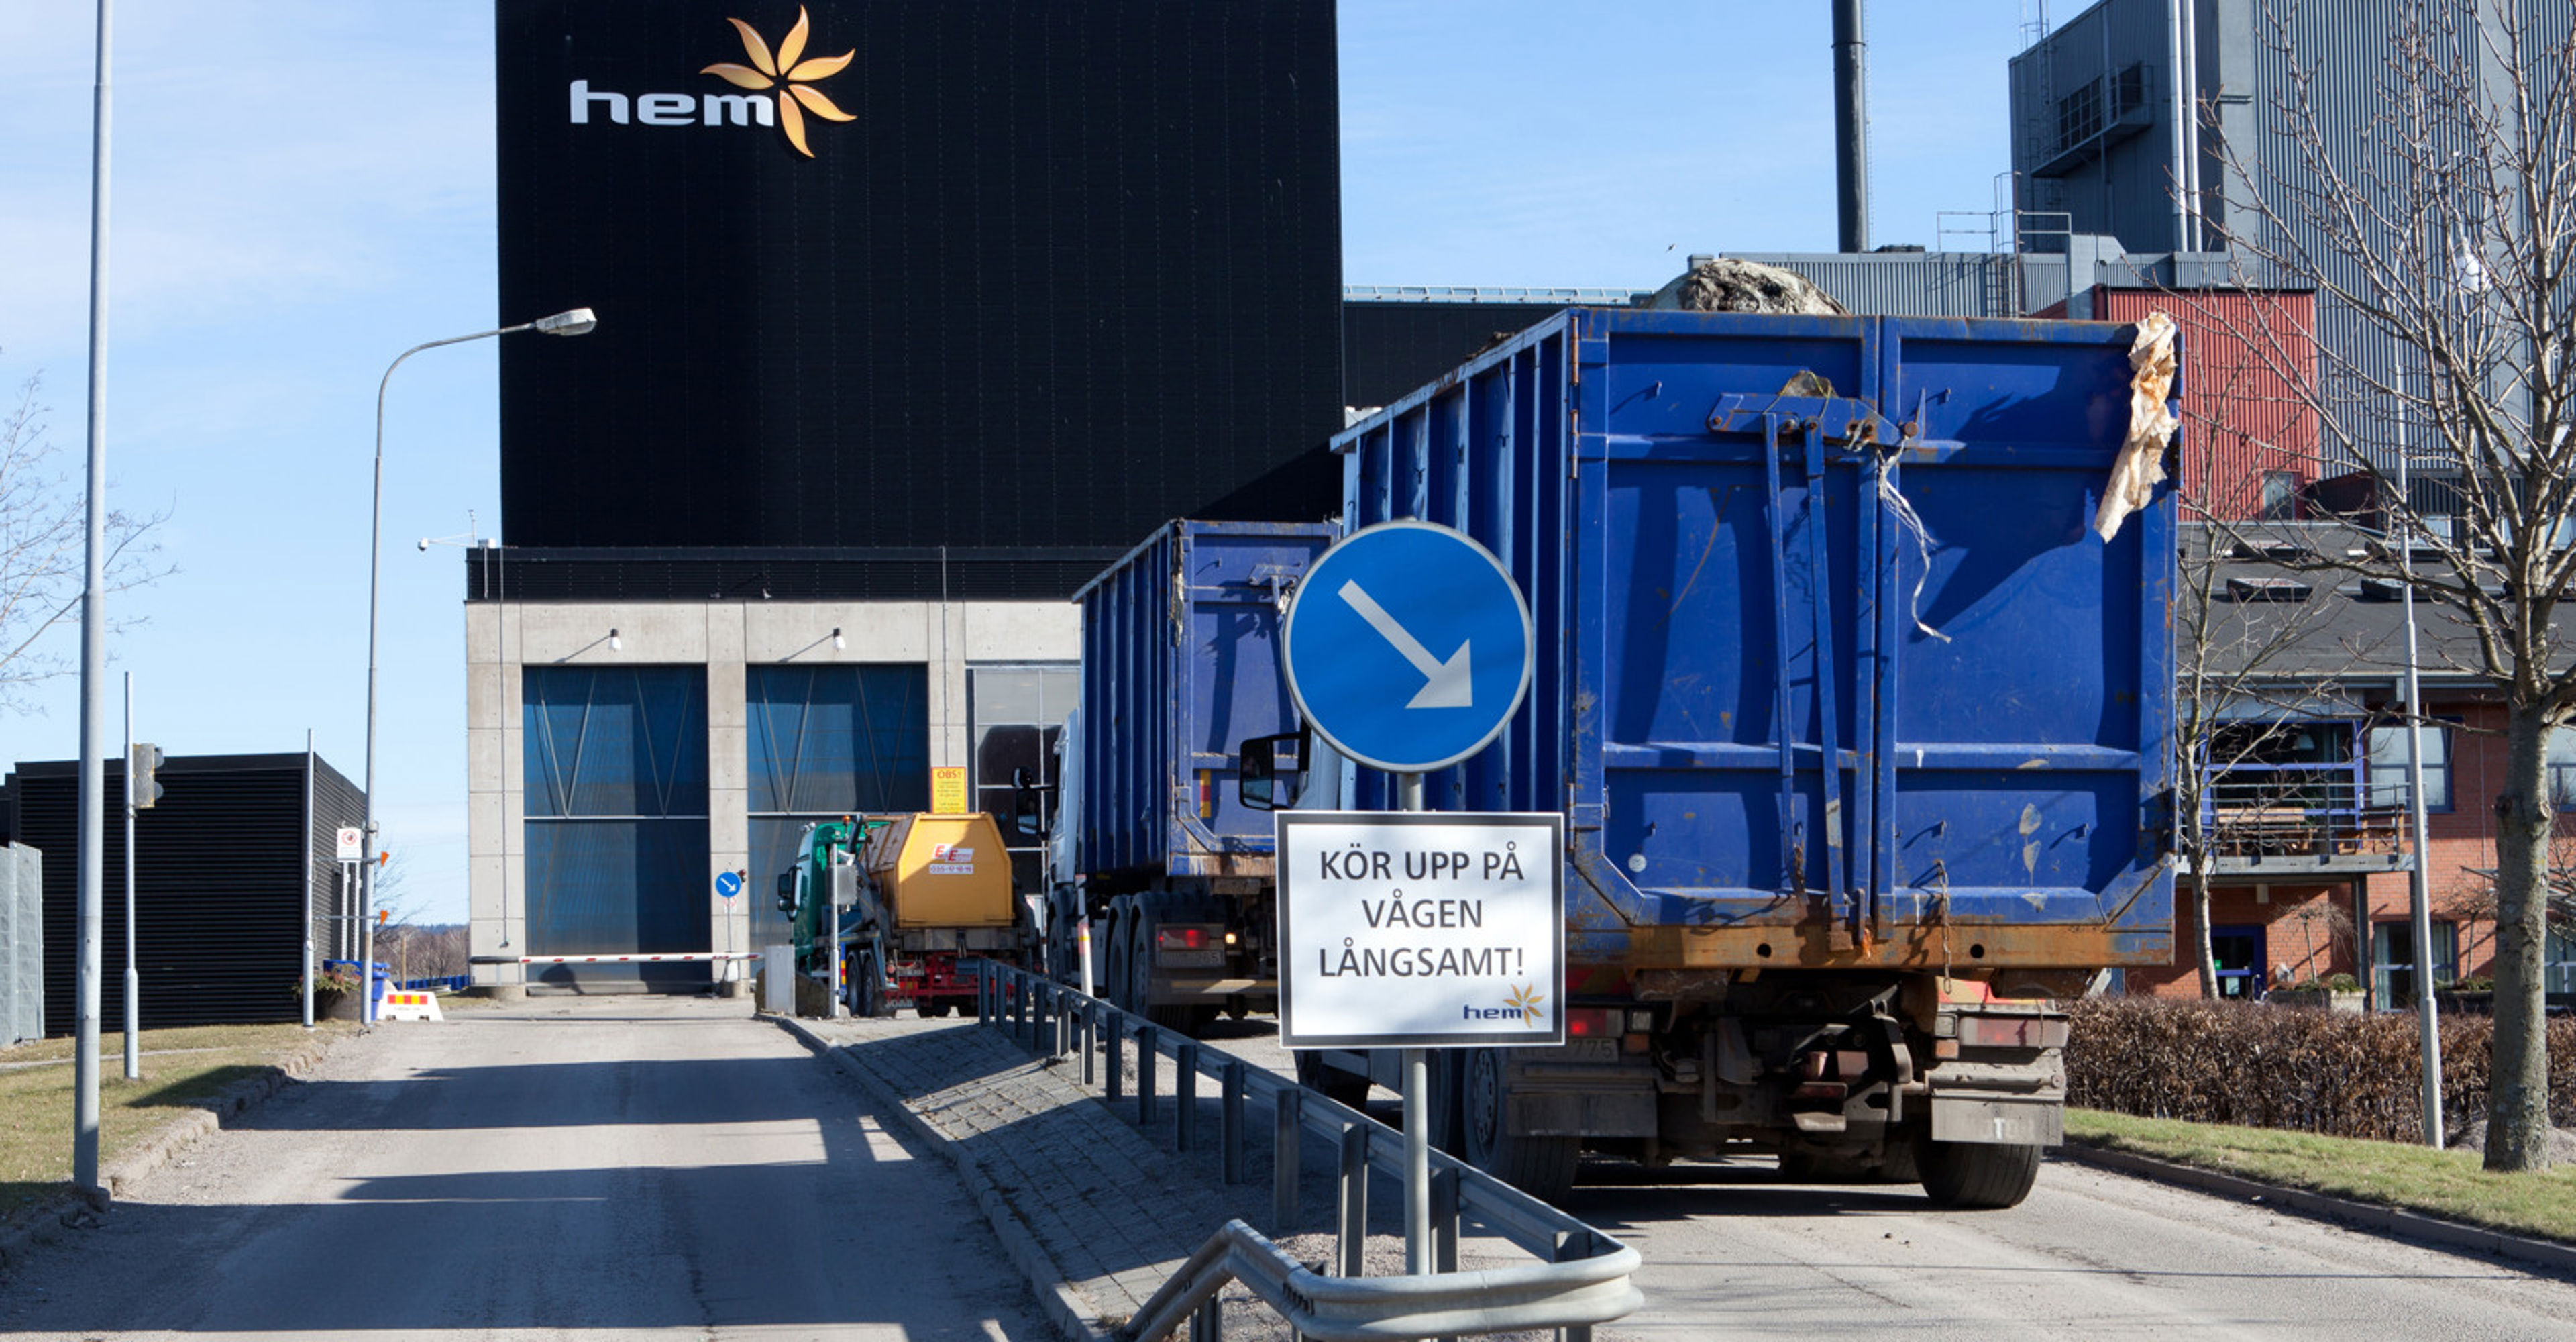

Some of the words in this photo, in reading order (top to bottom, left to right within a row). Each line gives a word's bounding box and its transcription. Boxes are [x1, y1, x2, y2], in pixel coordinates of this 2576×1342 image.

[570, 80, 774, 127] hem
[936, 770, 961, 779] OBS!
[1320, 843, 1392, 880] KÖR
[1405, 851, 1470, 880] UPP
[1483, 841, 1524, 880] PÅ
[1361, 888, 1482, 928] VÅGEN
[1319, 937, 1523, 977] LÅNGSAMT!
[1463, 1004, 1522, 1019] hem
